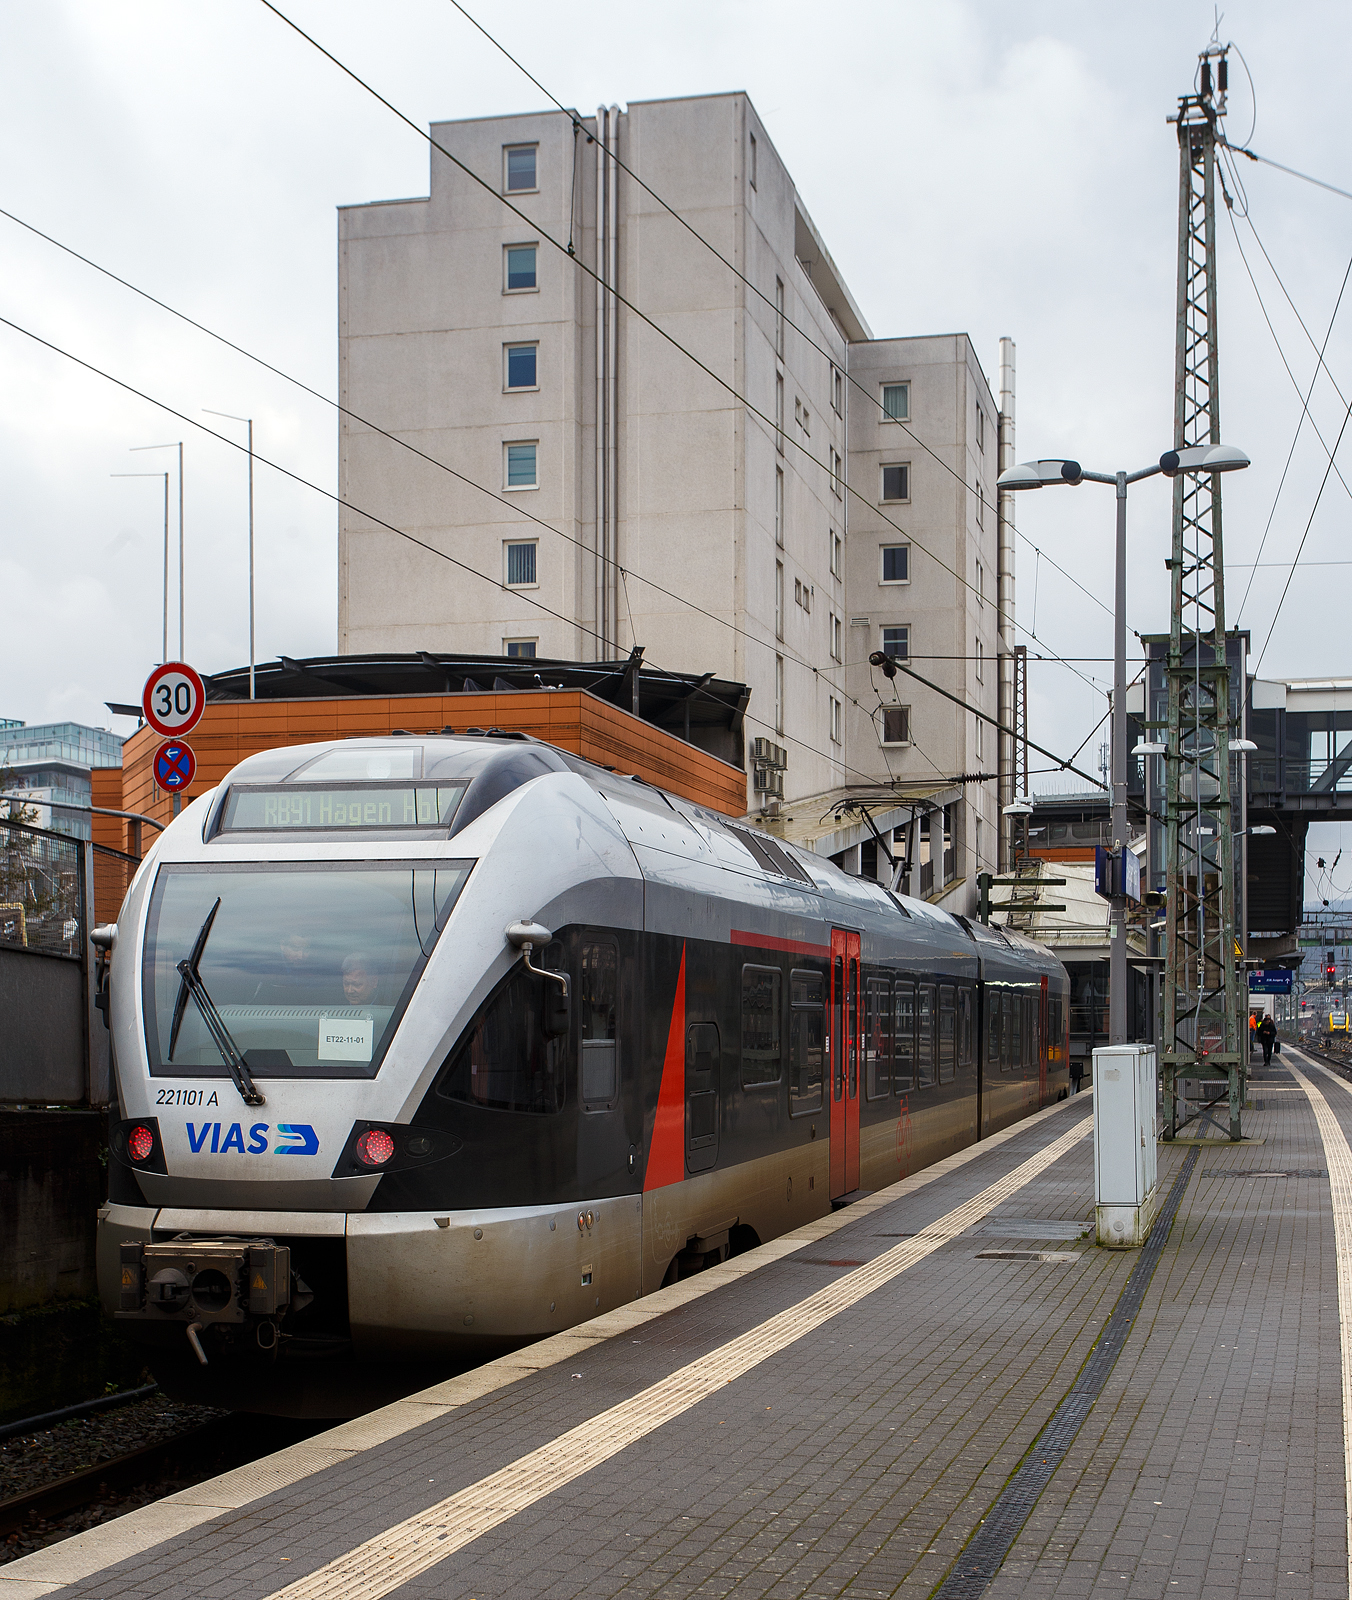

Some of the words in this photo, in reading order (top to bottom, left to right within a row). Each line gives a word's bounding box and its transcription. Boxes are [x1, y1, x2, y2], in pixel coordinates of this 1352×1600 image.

[155, 682, 191, 717] 30
[264, 795, 311, 824] RB91
[319, 795, 391, 825] Hagen
[403, 793, 442, 823] Hbf
[861, 1000, 866, 1031] 2
[326, 1035, 364, 1044] ET22-11-01
[155, 1089, 203, 1106] 221101
[207, 1091, 219, 1106] A
[186, 1123, 269, 1154] VIAS
